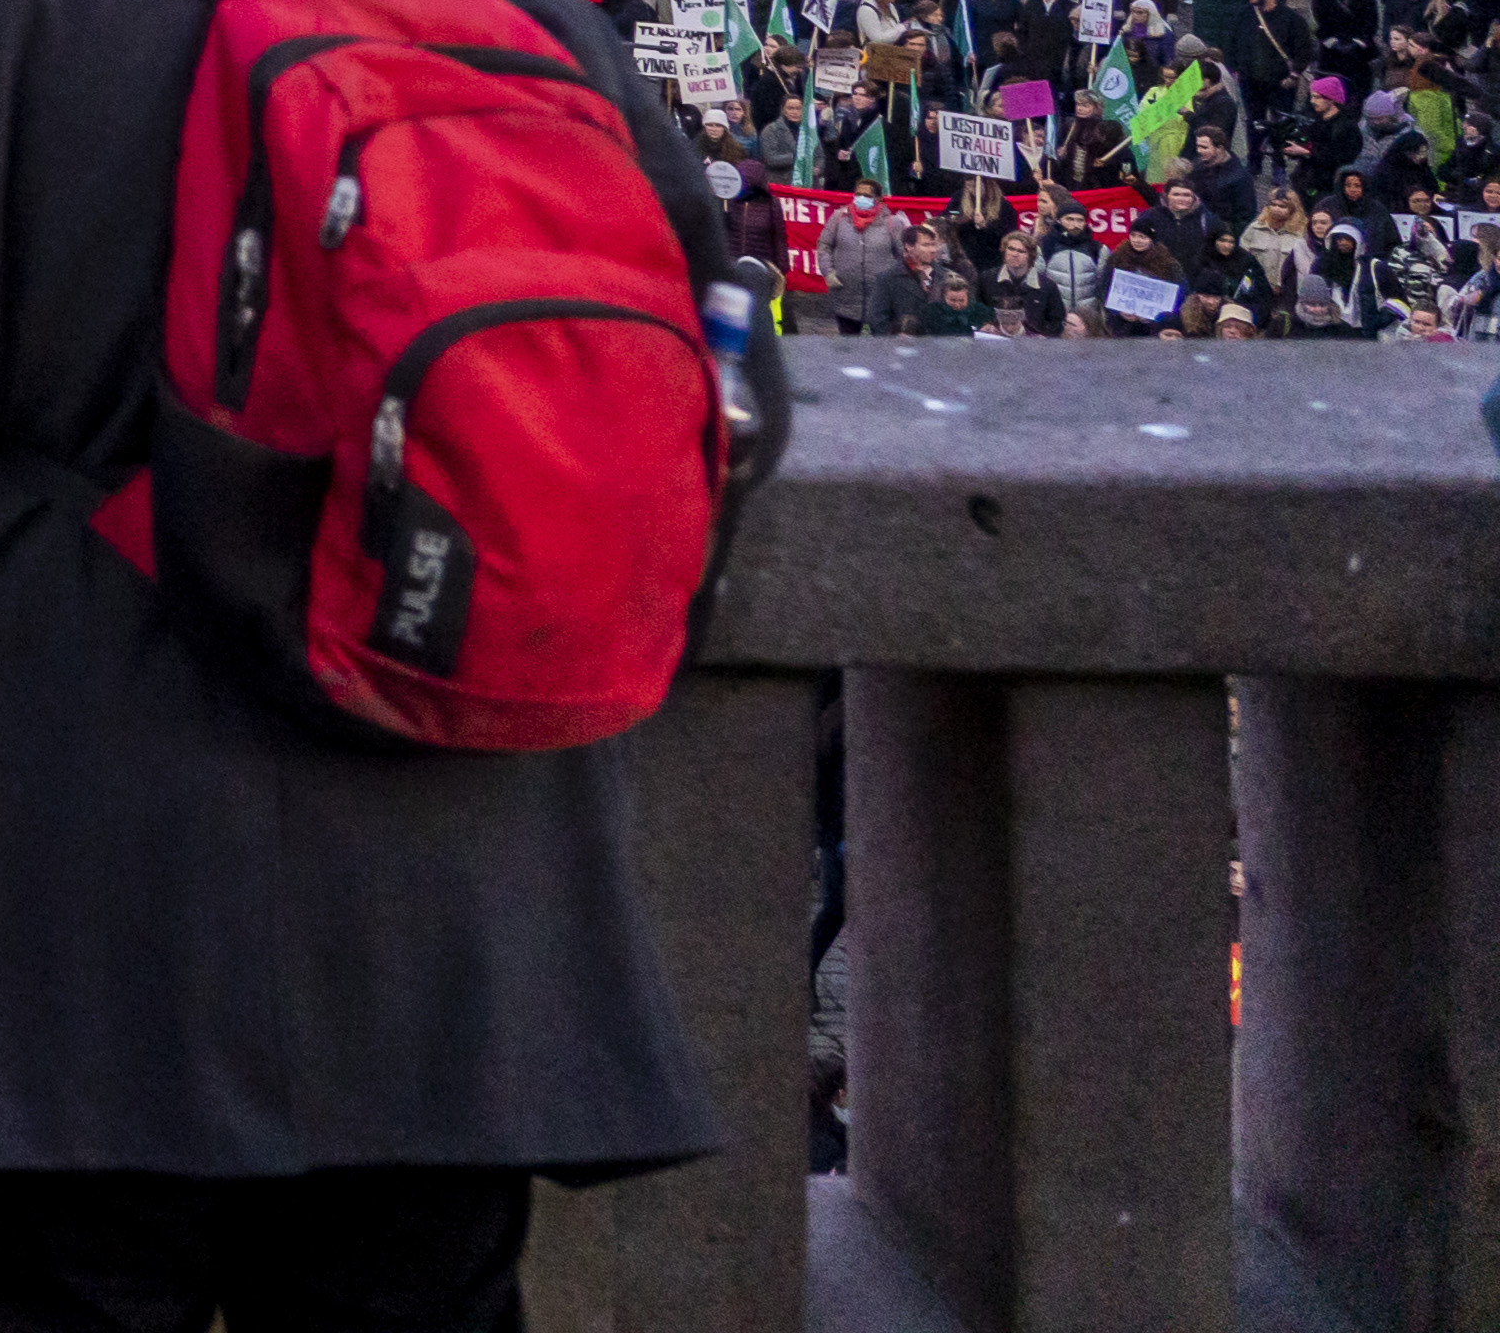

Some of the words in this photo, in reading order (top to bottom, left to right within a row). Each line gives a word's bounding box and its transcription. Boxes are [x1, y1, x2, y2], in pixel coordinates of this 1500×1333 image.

[687, 79, 713, 93] UKE
[942, 116, 1011, 142] LIKESTILLING
[951, 134, 973, 150] FOR
[974, 139, 1003, 158] ALLE
[959, 151, 1000, 175] KJØNN
[392, 530, 451, 646] PULSE
